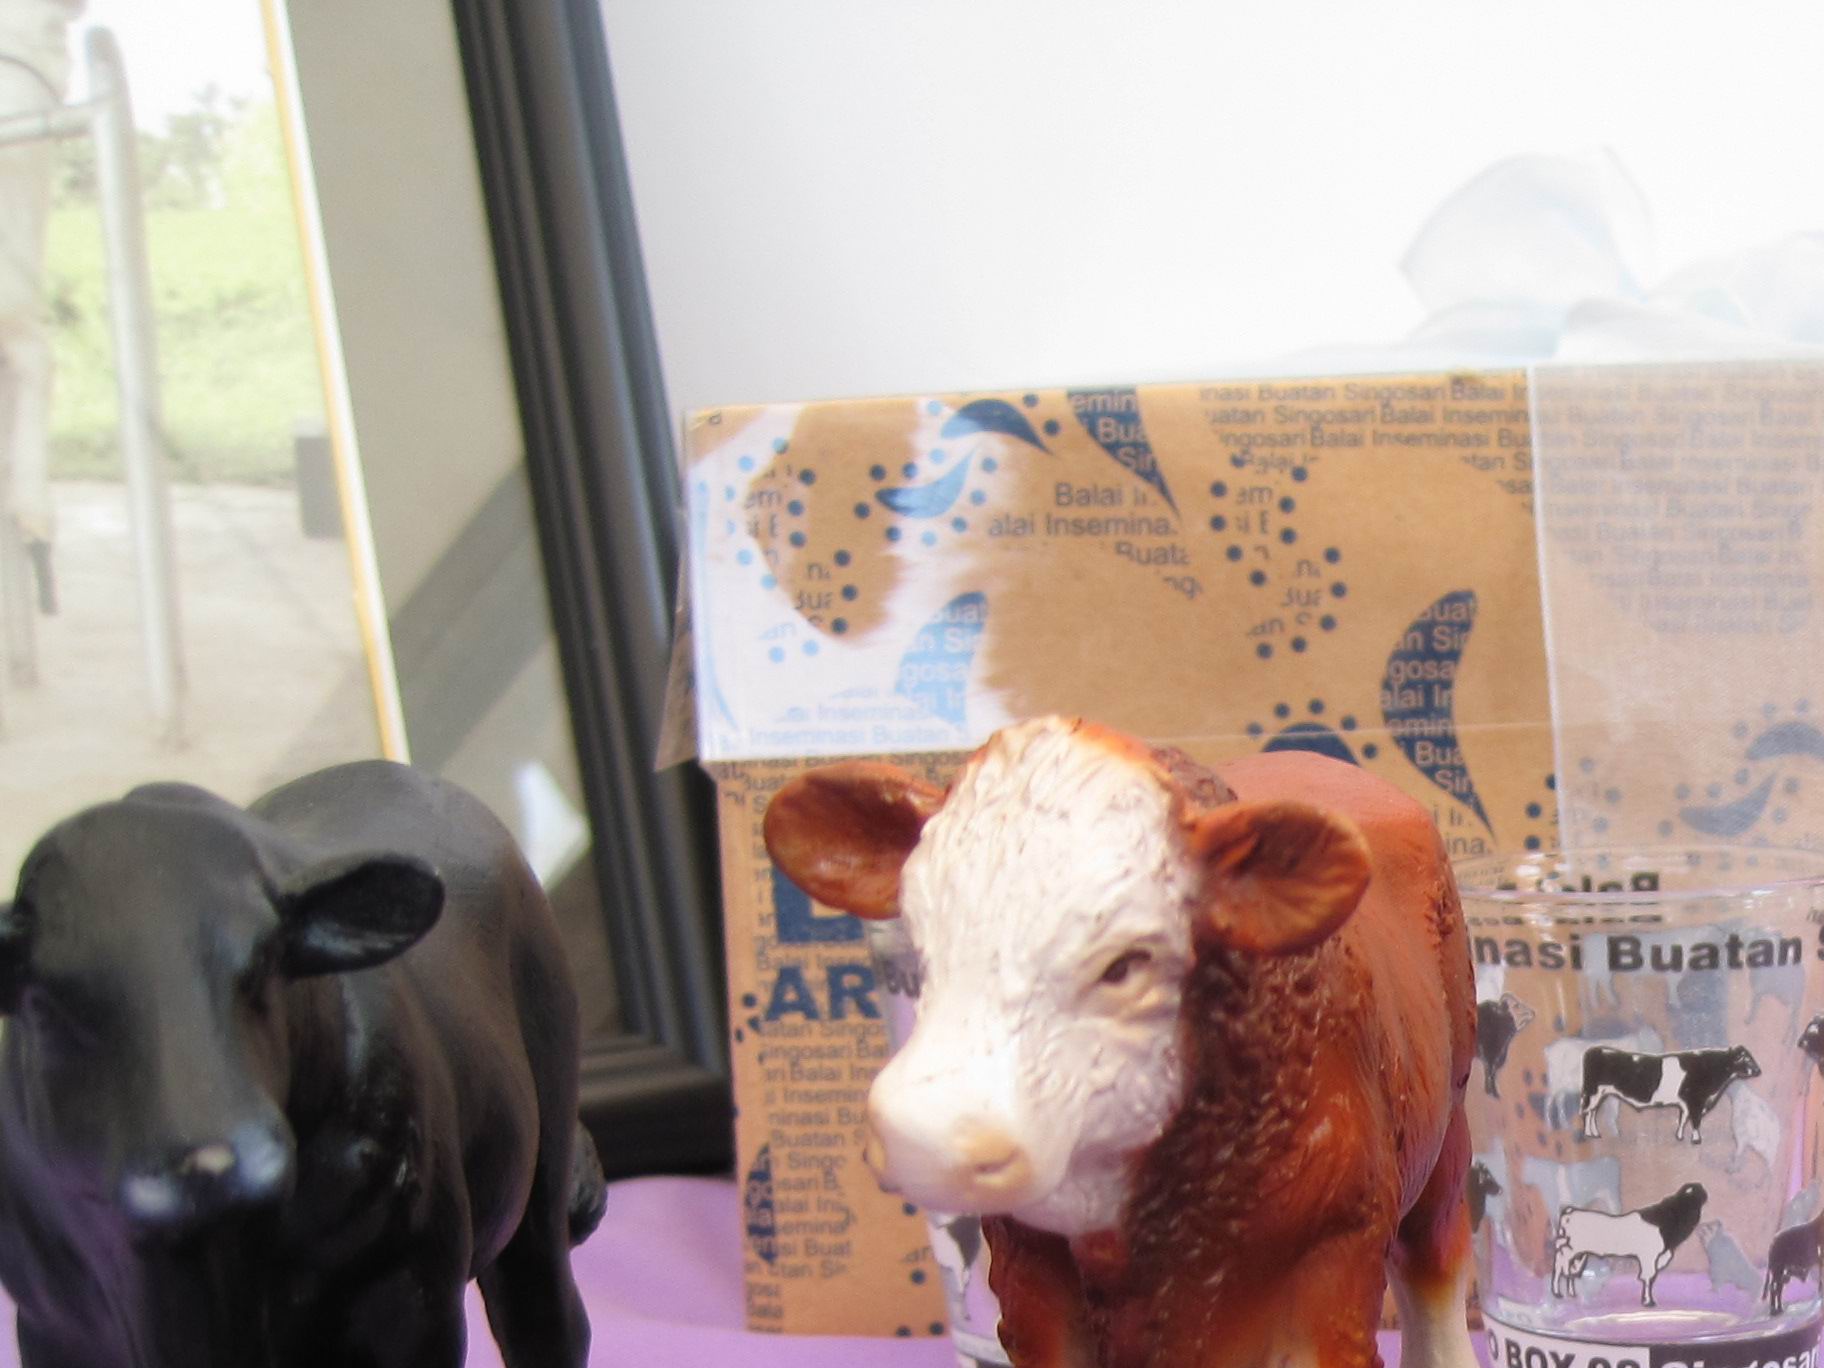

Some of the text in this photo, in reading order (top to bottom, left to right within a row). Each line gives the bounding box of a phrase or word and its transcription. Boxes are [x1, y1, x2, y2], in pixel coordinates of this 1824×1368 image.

[1055, 481, 1123, 507] Balai
[1046, 512, 1178, 538] Insemina
[1474, 933, 1583, 970] nasi
[1606, 932, 1803, 972] Buatan
